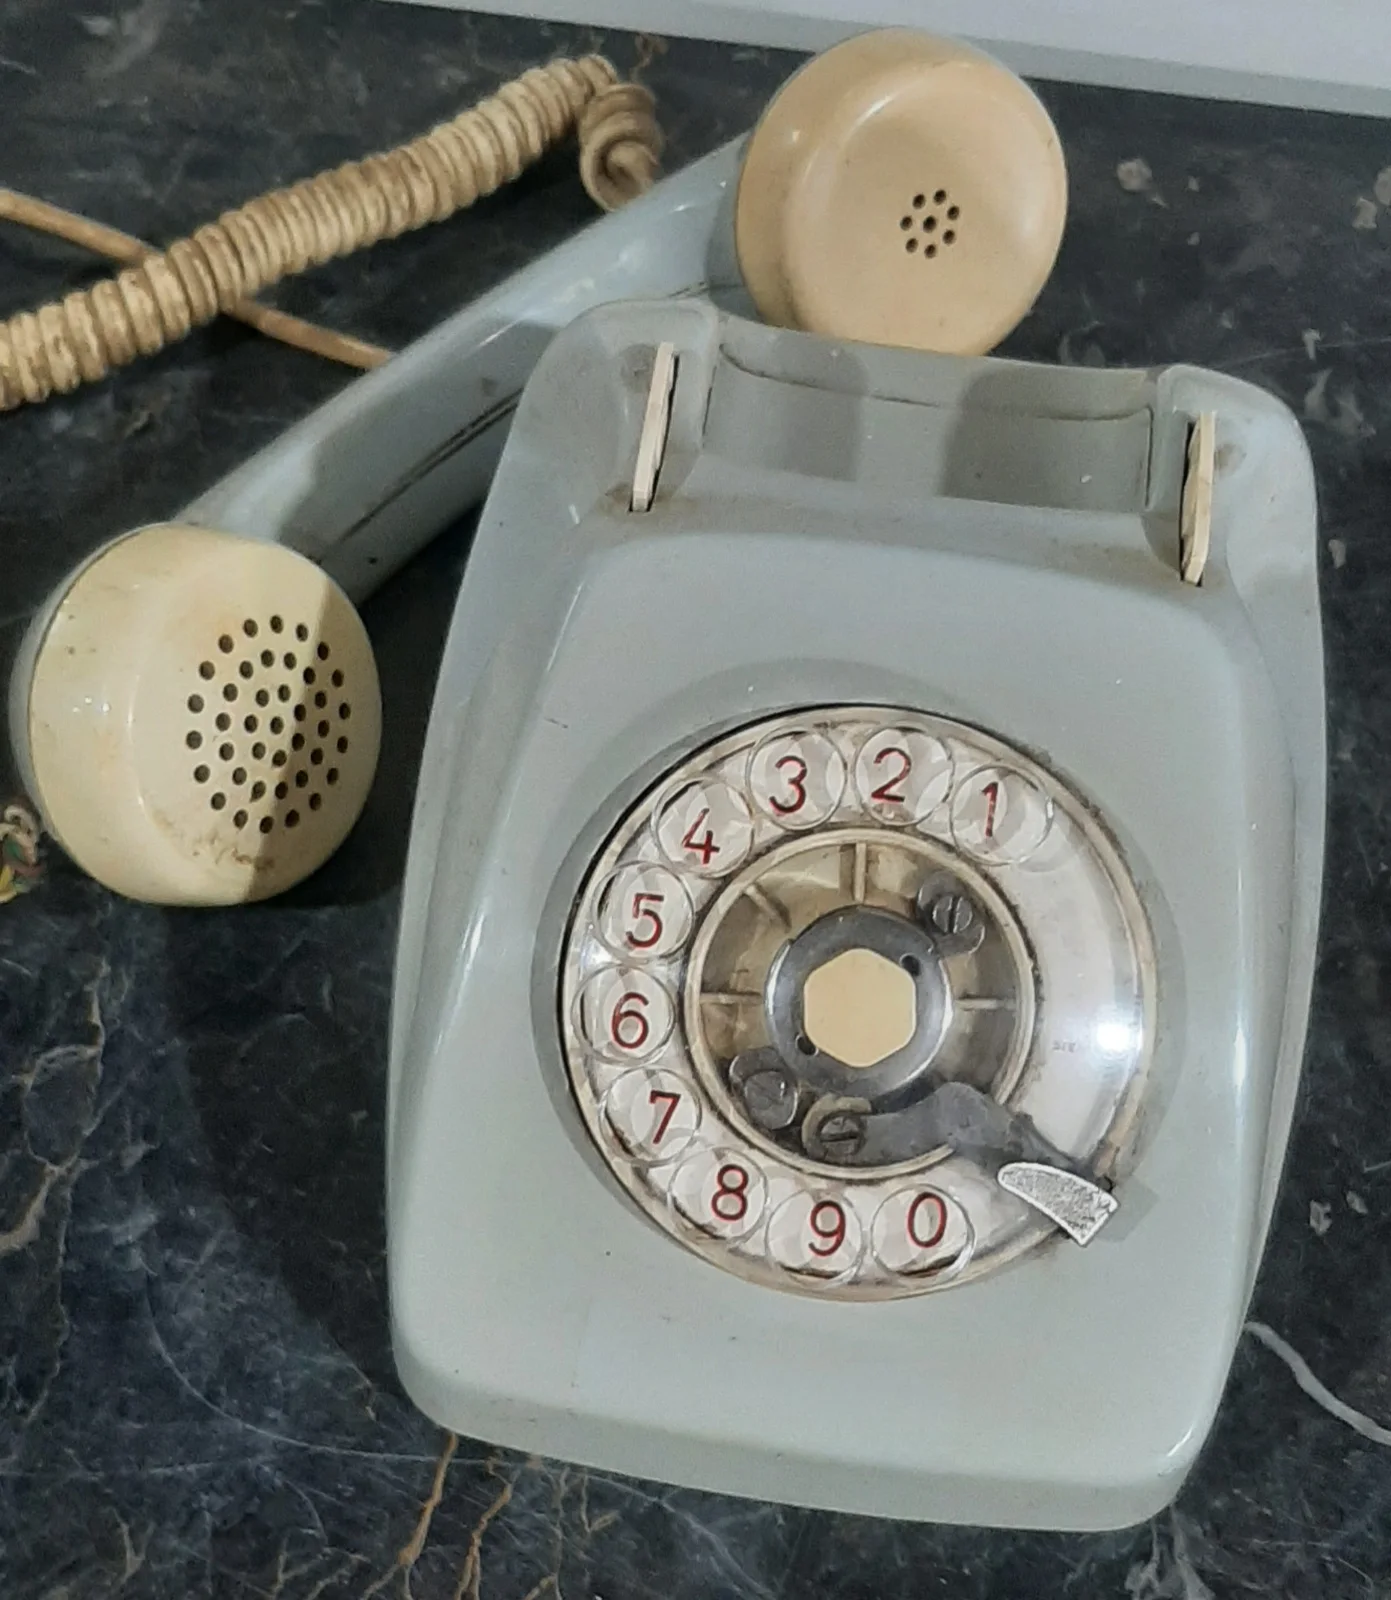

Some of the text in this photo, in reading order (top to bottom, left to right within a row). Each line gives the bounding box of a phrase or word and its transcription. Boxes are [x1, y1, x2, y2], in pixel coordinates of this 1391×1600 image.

[769, 755, 807, 816] 3
[871, 747, 911, 802] 2
[681, 808, 720, 865] 4
[981, 782, 999, 837] 1
[625, 893, 664, 949] 5
[610, 992, 649, 1049] 6
[648, 1090, 681, 1145] 7
[711, 1164, 749, 1222] 8
[907, 1191, 947, 1248] 0
[808, 1200, 846, 1257] 9
